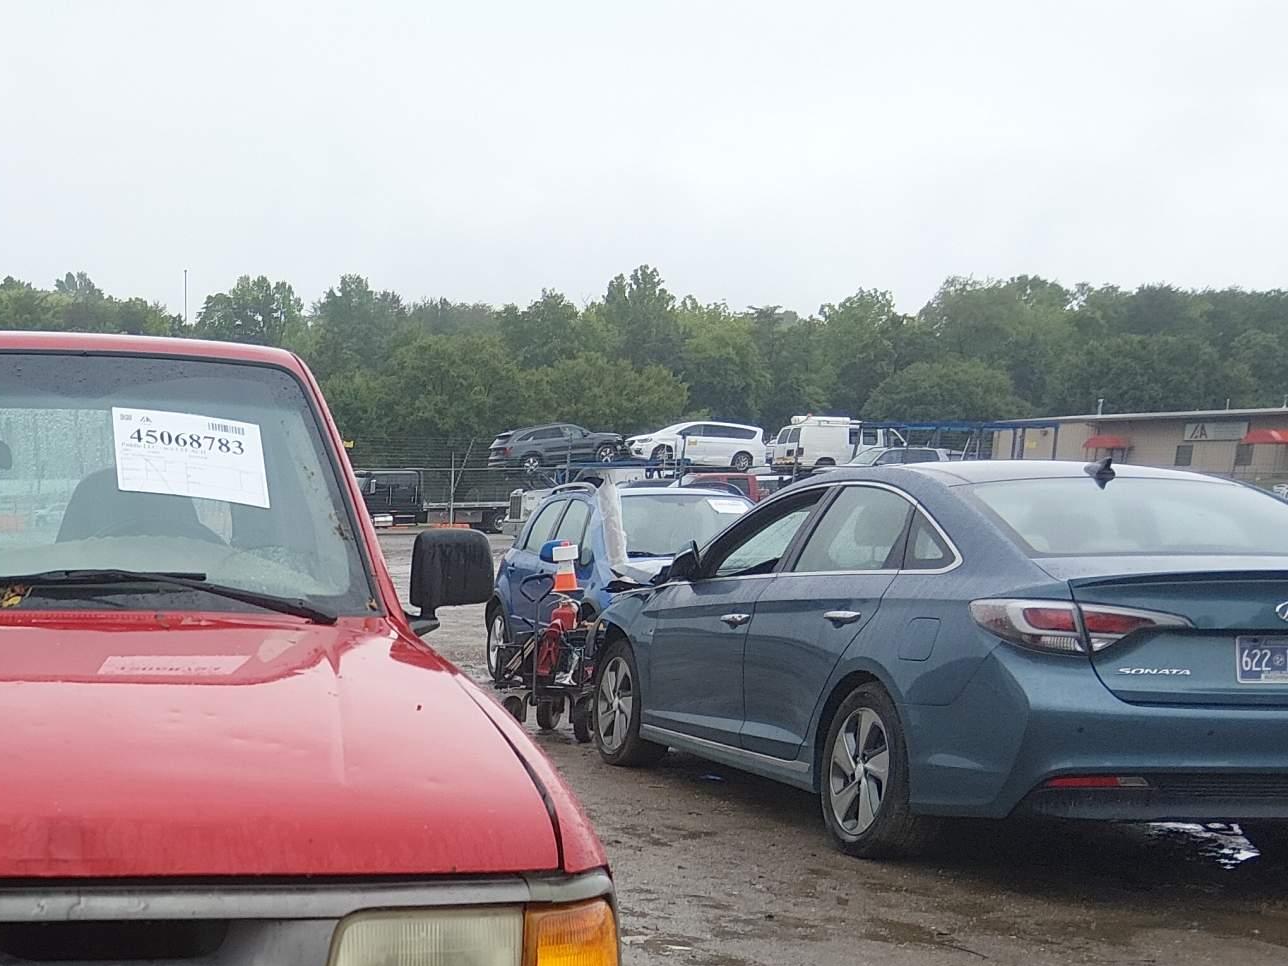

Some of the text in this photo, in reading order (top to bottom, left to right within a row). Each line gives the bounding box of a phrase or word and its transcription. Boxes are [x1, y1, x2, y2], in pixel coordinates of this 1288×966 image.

[129, 428, 245, 456] 45068783
[1242, 649, 1272, 671] 622
[1115, 667, 1192, 676] SONATA
